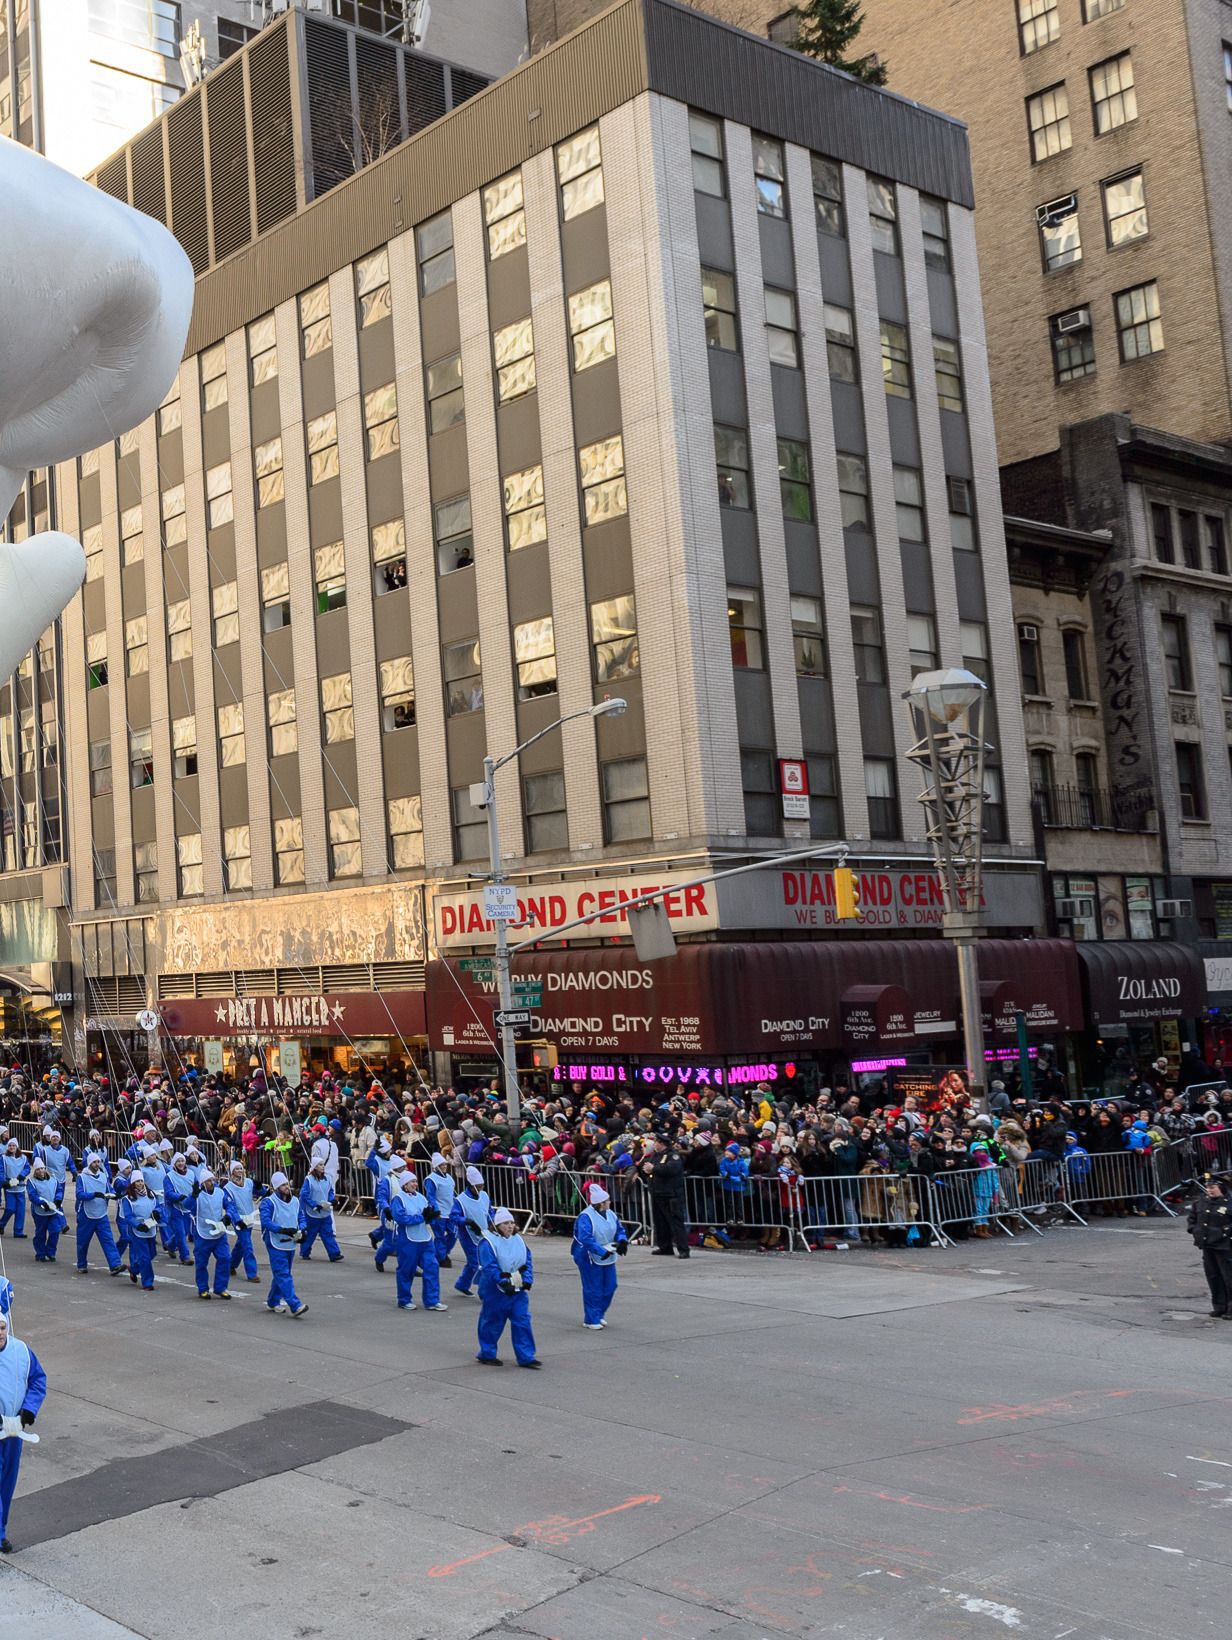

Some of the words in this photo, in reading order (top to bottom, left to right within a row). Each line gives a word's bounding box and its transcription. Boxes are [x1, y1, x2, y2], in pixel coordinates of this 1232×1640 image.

[795, 910, 816, 924] WE
[857, 910, 892, 924] GOLD
[899, 910, 908, 924] &
[477, 972, 482, 980] 6
[548, 970, 653, 991] DIAMONDS
[1118, 976, 1181, 1000] ZOLAND
[526, 996, 534, 1006] 47
[228, 998, 256, 1028] PRET
[260, 998, 268, 1026] A
[273, 996, 330, 1027] MANGER
[914, 1010, 941, 1018] JEWELRY
[530, 1016, 603, 1033] DIAMOND
[612, 1014, 653, 1032] CITY
[761, 1019, 804, 1032] DIAMOND
[808, 1016, 830, 1030] CITY
[560, 1037, 585, 1046] OPEN
[588, 1037, 593, 1046] 7
[595, 1036, 619, 1046] DAYS
[570, 1066, 587, 1080] BUY
[590, 1066, 614, 1080] GOLD
[618, 1066, 626, 1080] &
